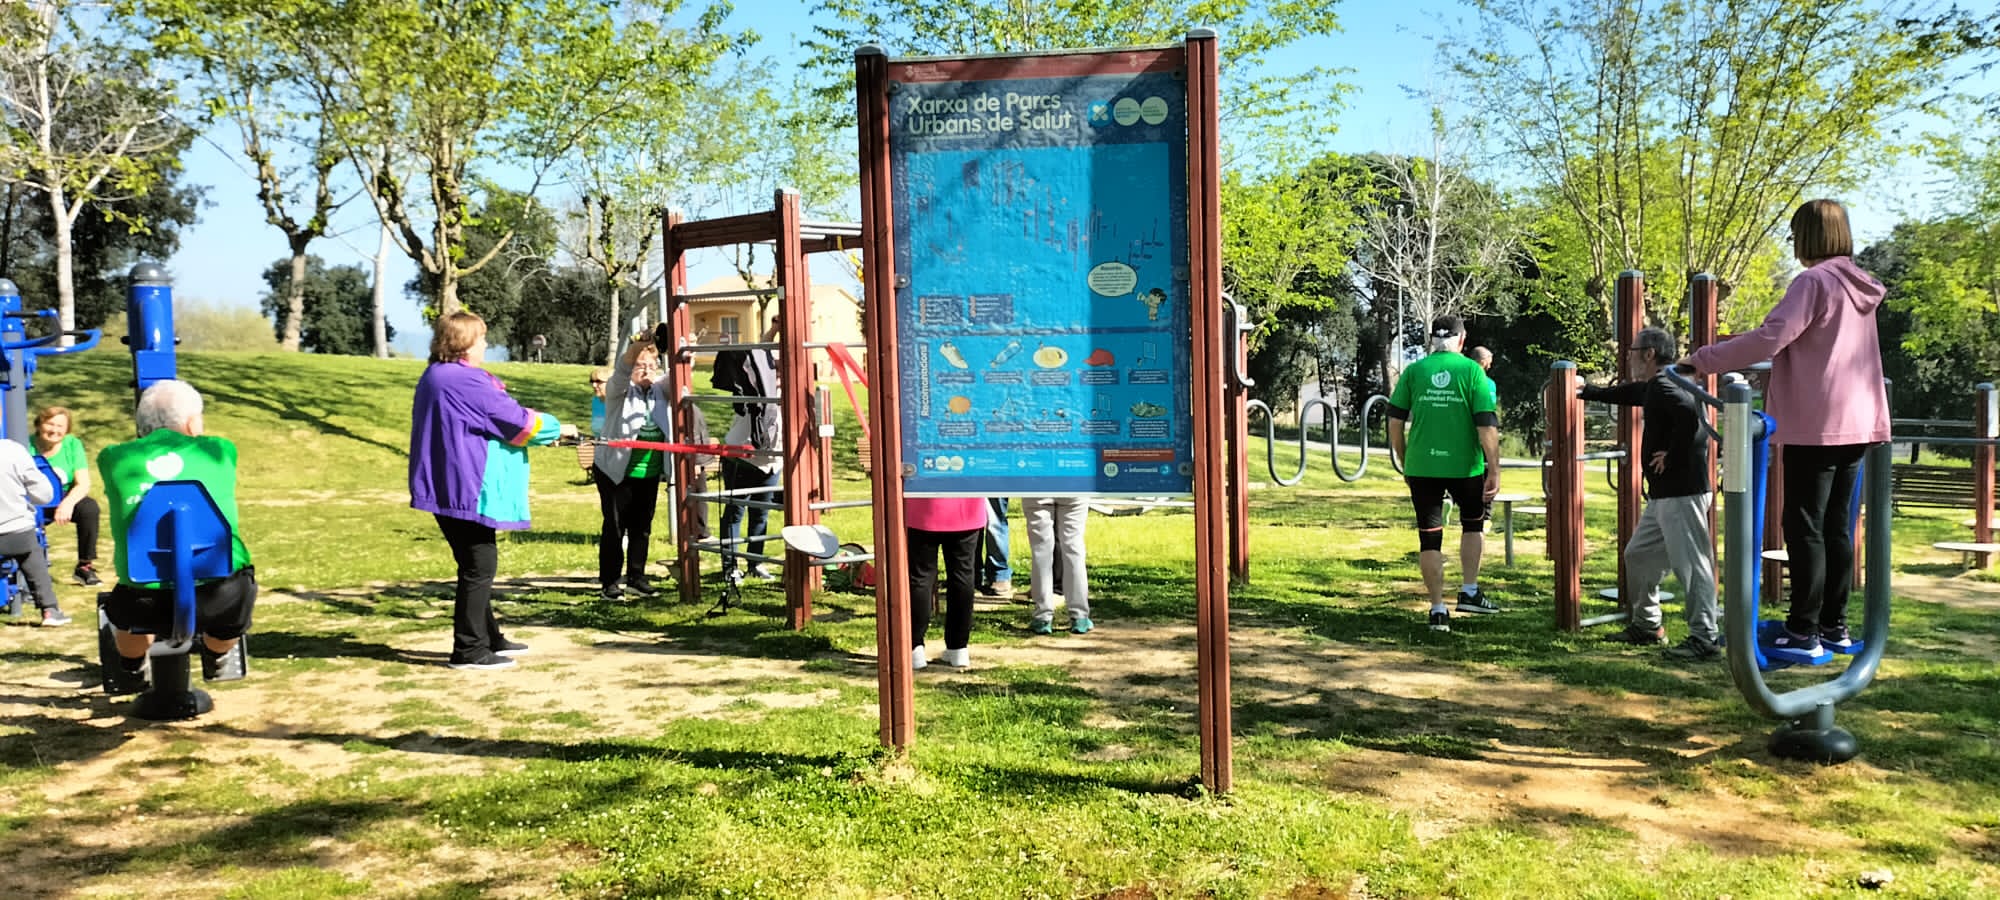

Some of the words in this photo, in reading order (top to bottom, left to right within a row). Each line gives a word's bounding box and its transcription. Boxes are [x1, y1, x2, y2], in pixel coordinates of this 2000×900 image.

[908, 96, 968, 115] Xarxa
[974, 92, 1000, 113] de
[1006, 92, 1061, 111] Parcs
[909, 115, 982, 134] Urbans
[988, 112, 1014, 131] de
[1020, 110, 1072, 130] Salut
